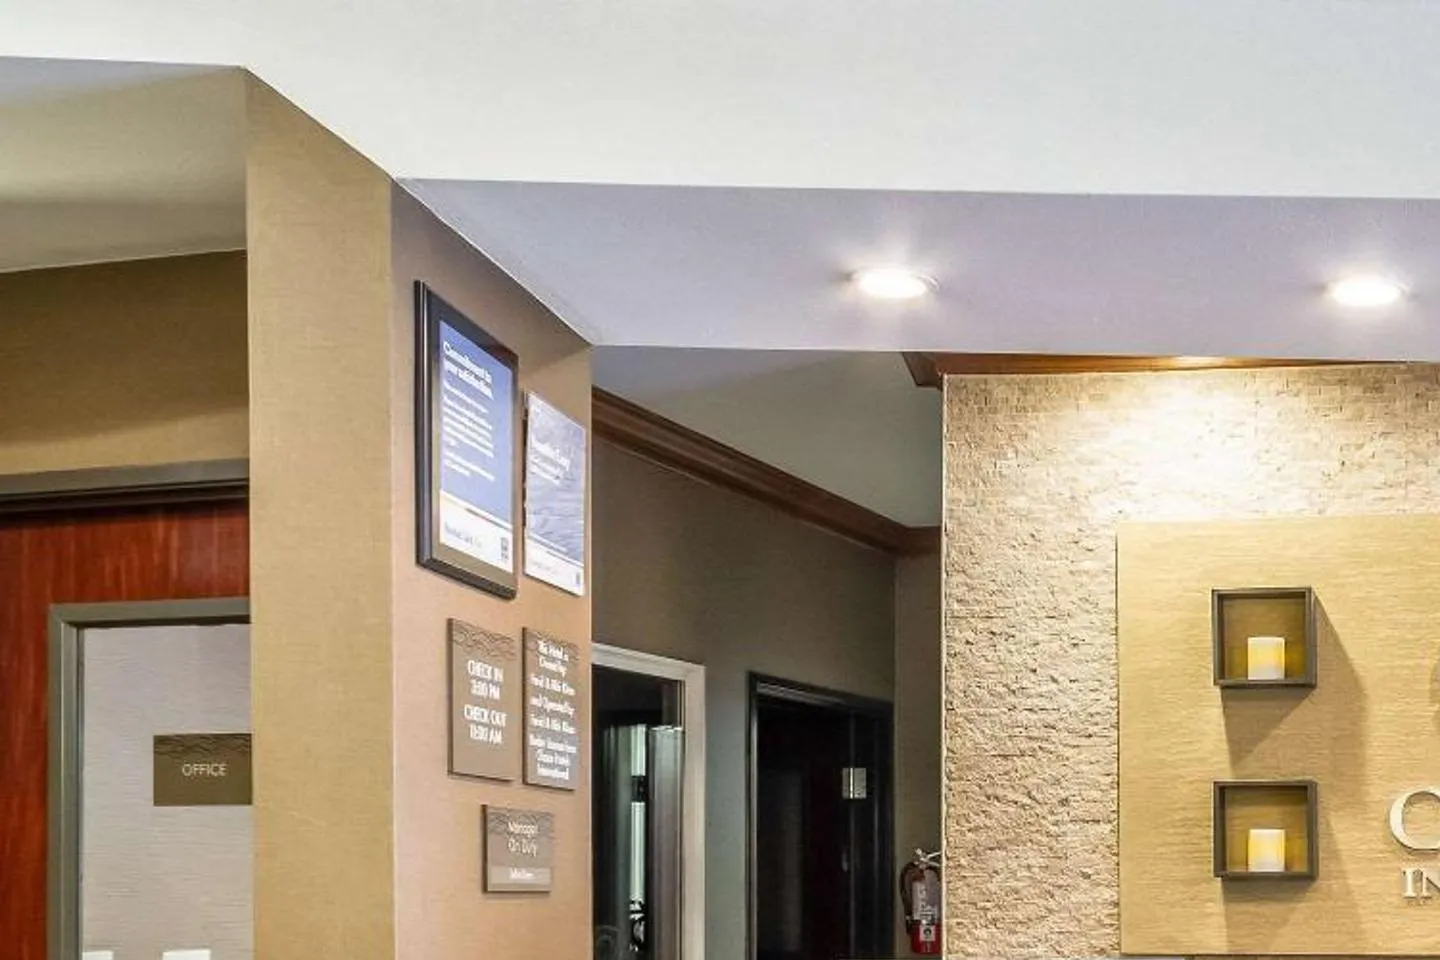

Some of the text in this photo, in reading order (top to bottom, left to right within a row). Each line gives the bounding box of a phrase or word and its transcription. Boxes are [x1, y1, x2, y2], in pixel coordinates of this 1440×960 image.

[467, 660, 504, 682] CHECK IN
[489, 683, 501, 700] PM
[464, 704, 490, 724] CHECK
[490, 710, 508, 727] OUT
[489, 727, 503, 745] AM
[182, 762, 228, 777] OFFICE
